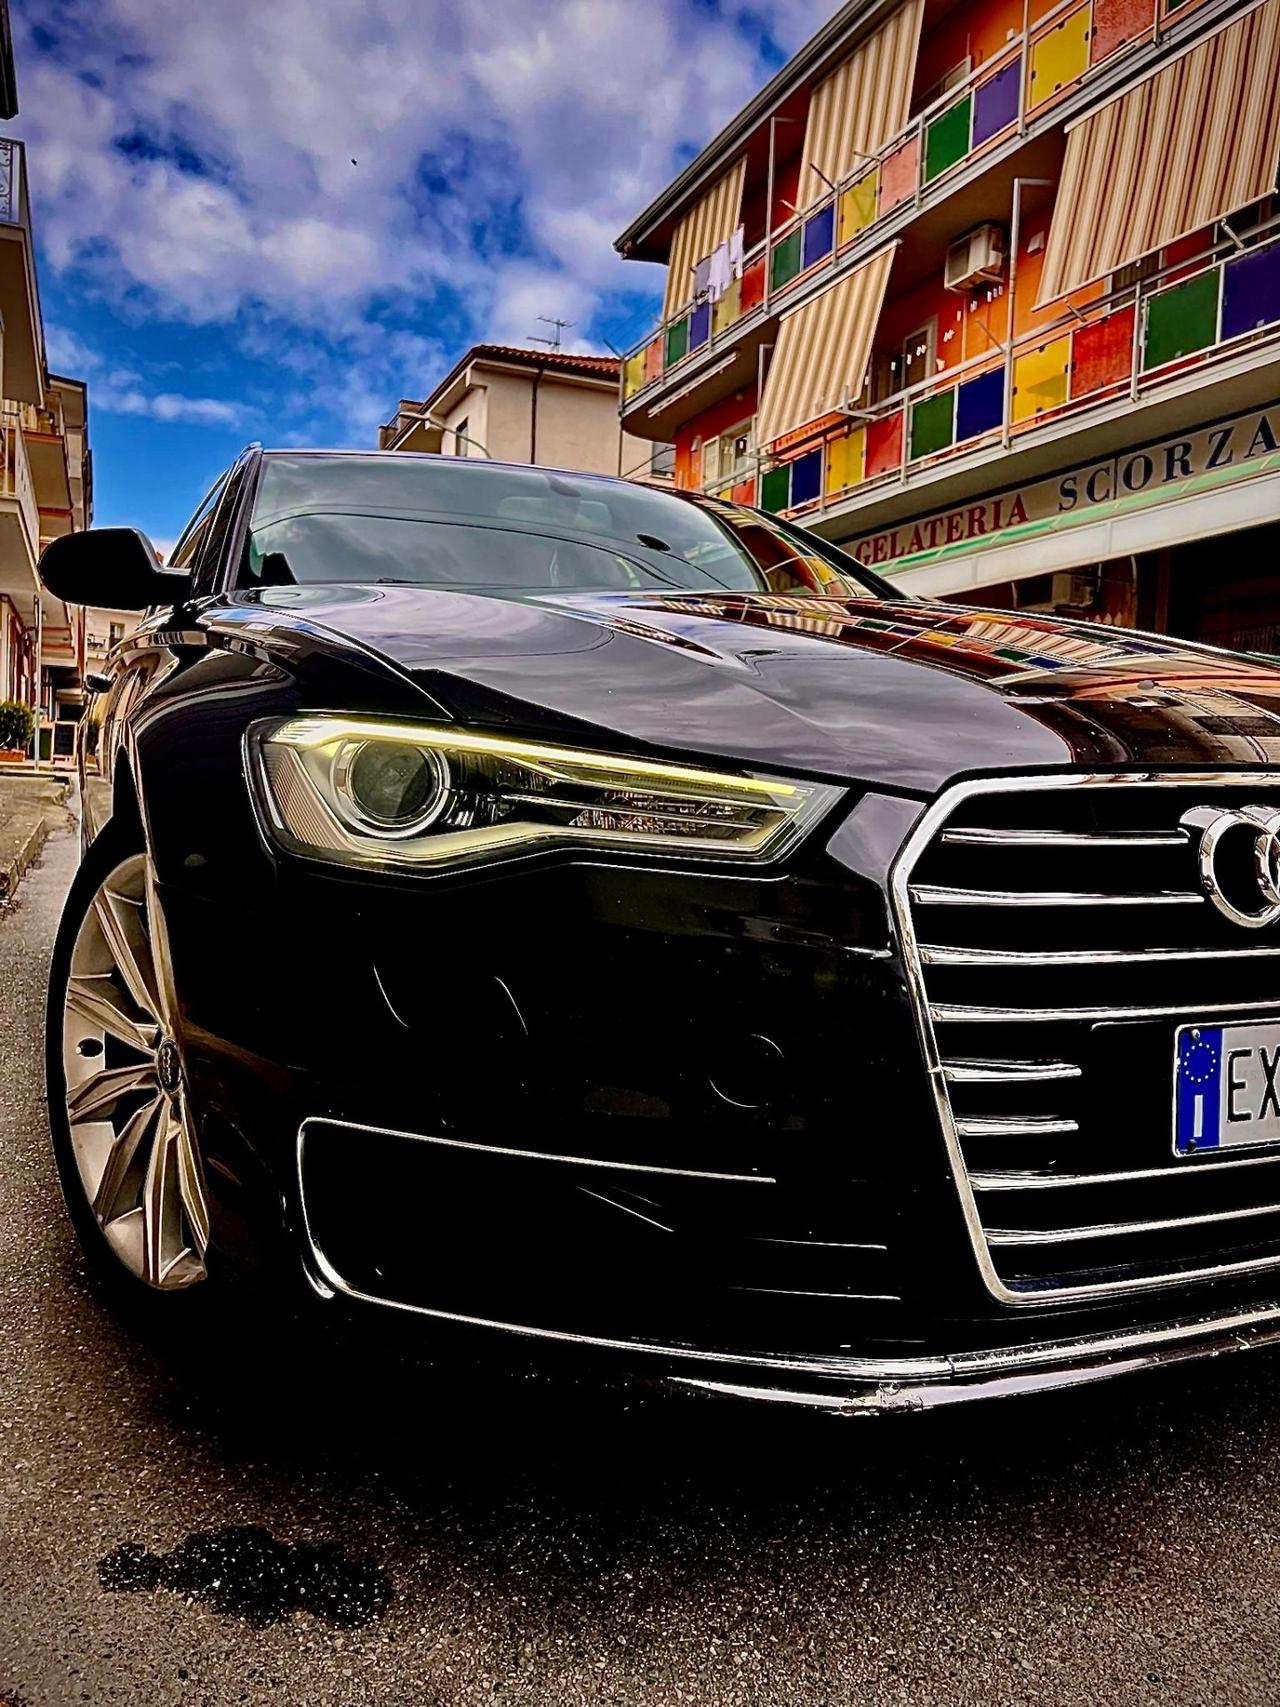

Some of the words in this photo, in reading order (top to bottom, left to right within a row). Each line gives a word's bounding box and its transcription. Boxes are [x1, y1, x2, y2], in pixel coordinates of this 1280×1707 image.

[854, 493, 1029, 566] GELATERIA
[1058, 415, 1280, 512] SCORZA
[1193, 1094, 1204, 1138] I
